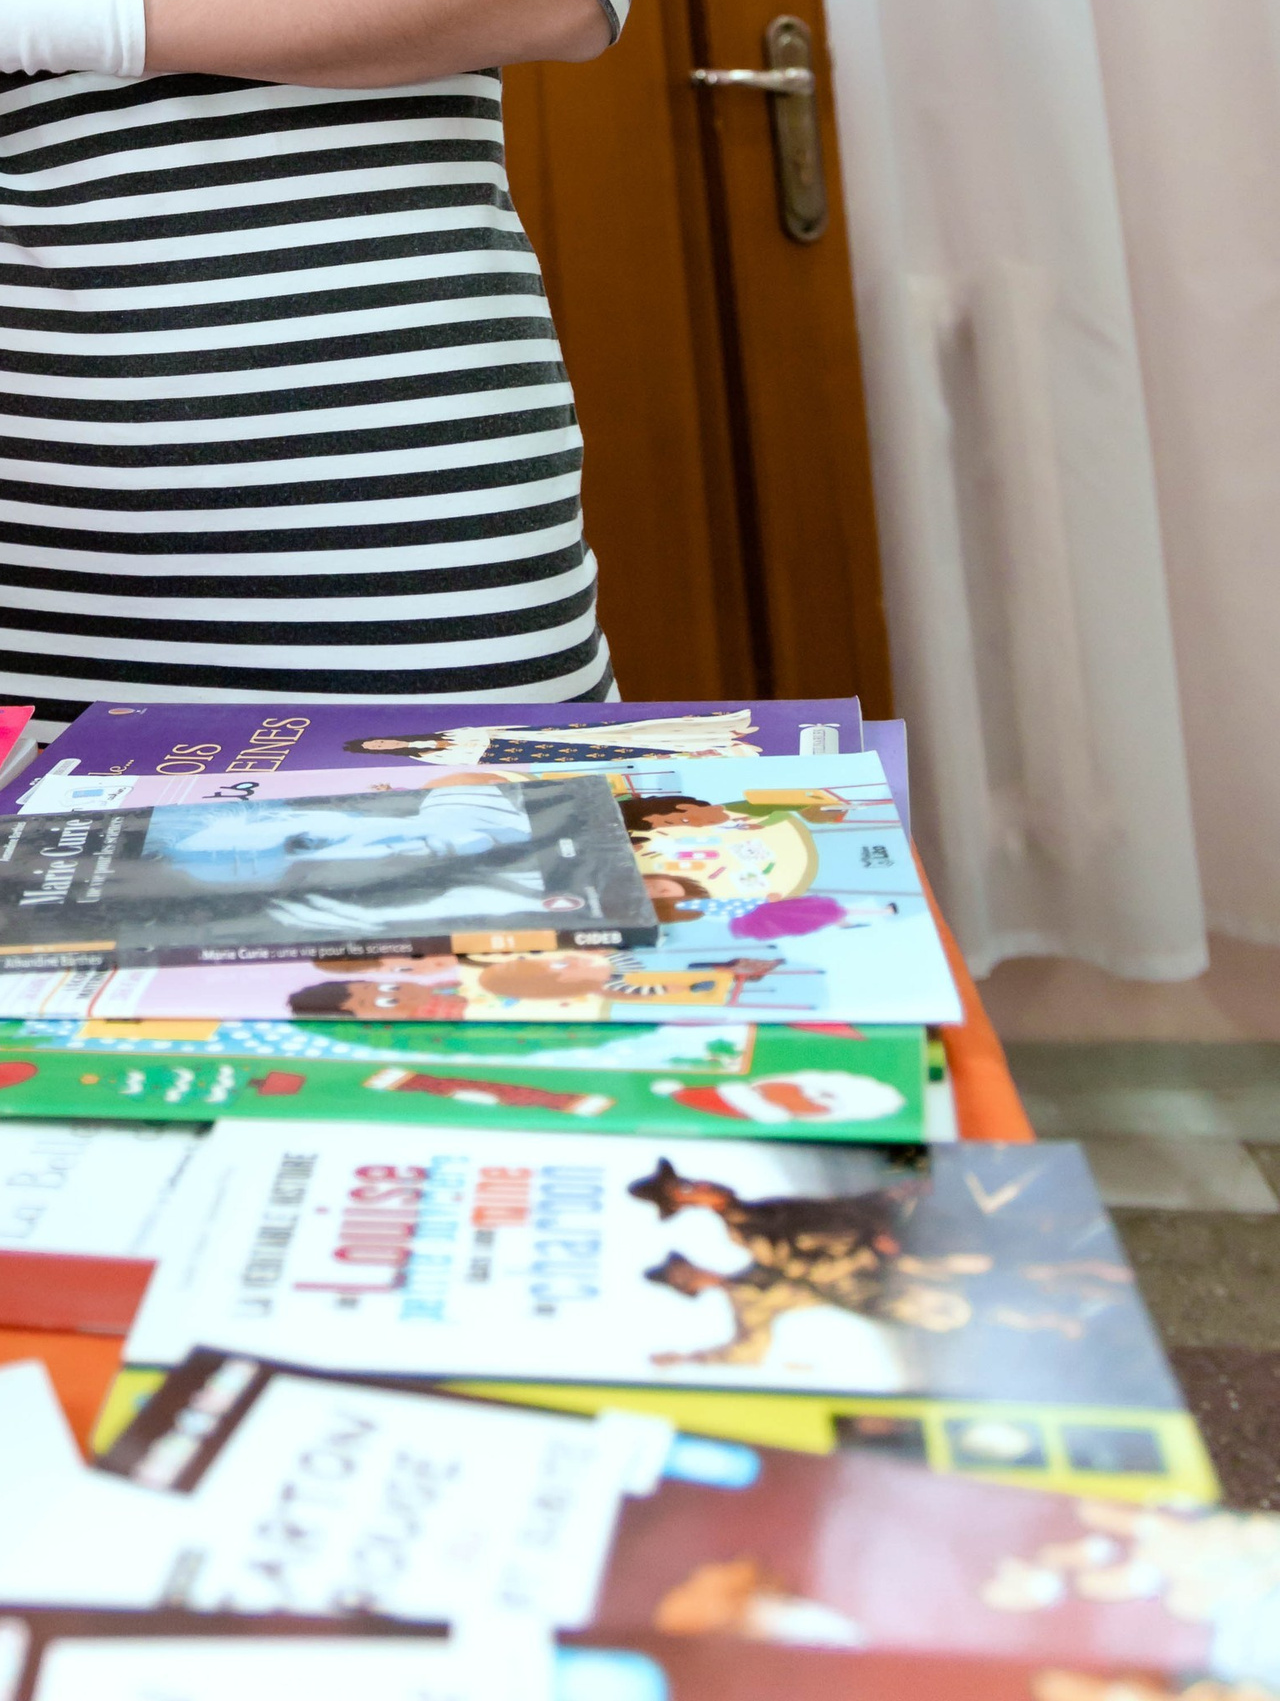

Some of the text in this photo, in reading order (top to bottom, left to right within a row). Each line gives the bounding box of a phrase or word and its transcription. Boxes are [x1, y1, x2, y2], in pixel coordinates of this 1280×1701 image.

[225, 716, 312, 774] EINES
[19, 818, 94, 906] Marie Curie
[200, 949, 237, 961] Marie
[237, 947, 269, 960] Curie
[276, 946, 299, 959] une
[300, 944, 317, 958] vie
[319, 944, 346, 960] pour
[347, 942, 364, 955] les
[366, 942, 413, 955] sciences
[573, 931, 623, 947] CIDEB
[292, 1164, 428, 1293] Louise
[529, 1165, 605, 1300] charbon
